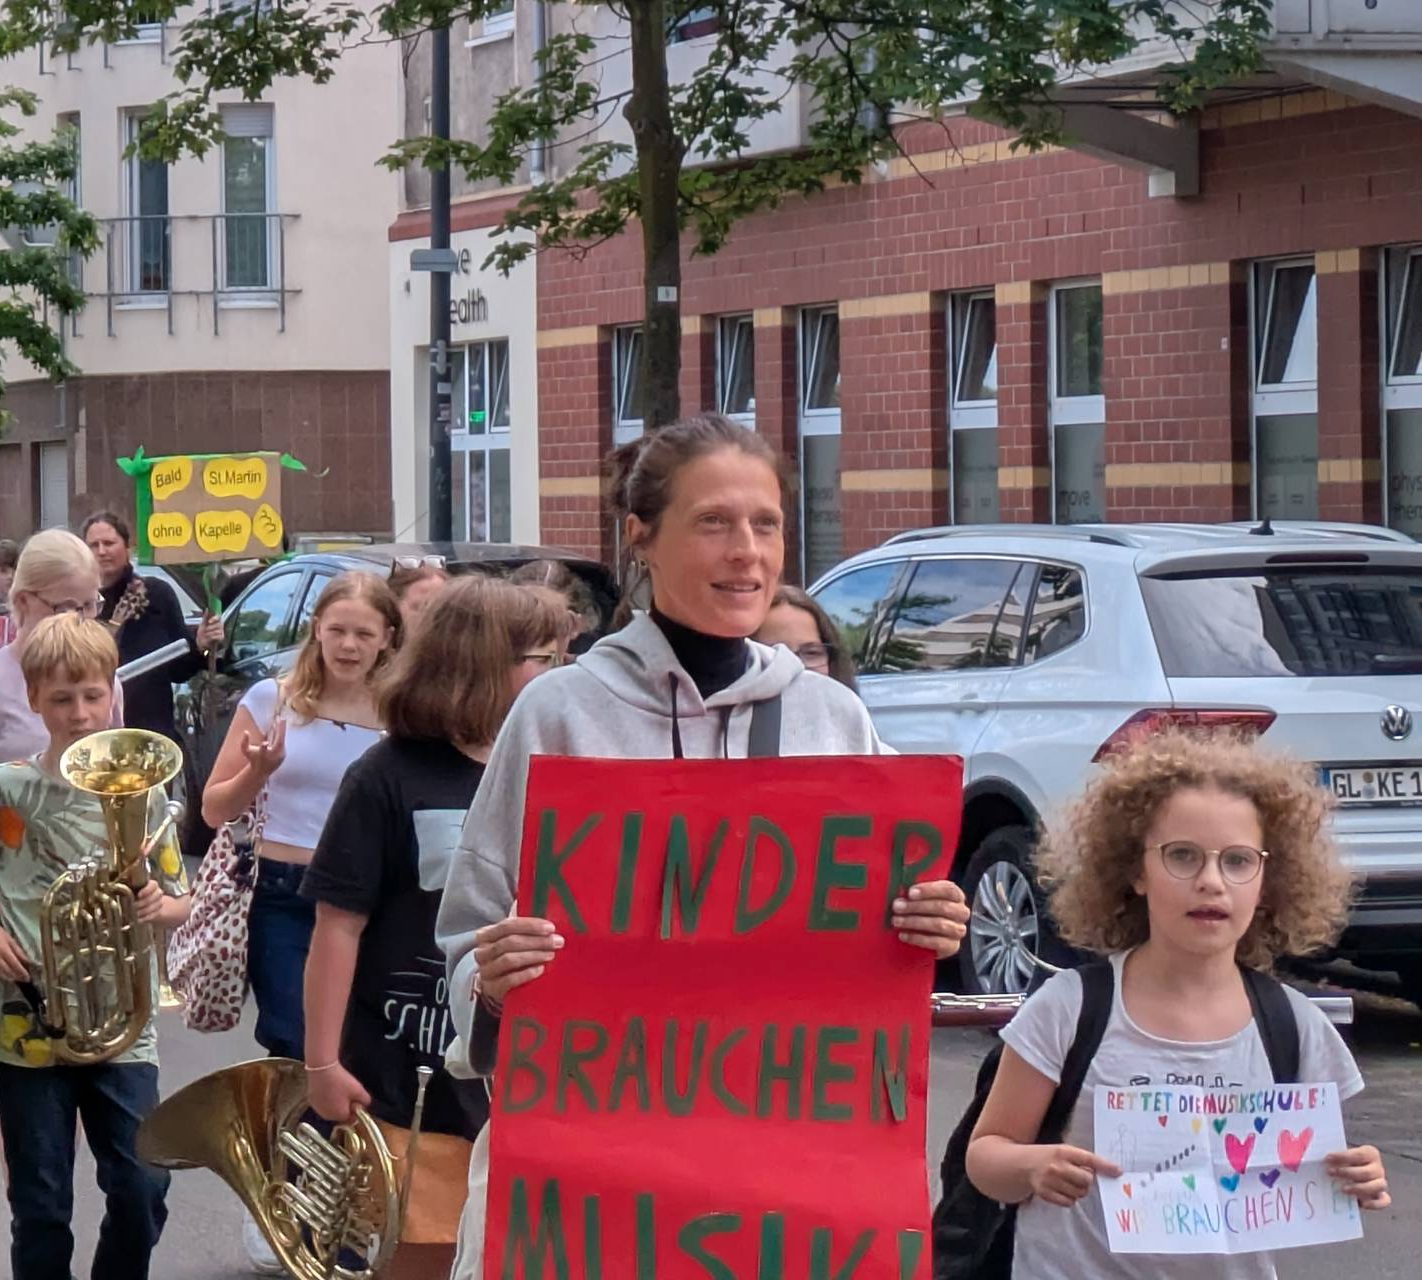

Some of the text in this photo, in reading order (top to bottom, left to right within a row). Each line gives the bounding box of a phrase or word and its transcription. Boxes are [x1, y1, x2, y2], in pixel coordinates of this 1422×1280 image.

[450, 287, 488, 324] ealth
[155, 467, 182, 488] Bald
[153, 524, 183, 538] ohne
[199, 521, 242, 539] Kapelle
[1333, 773, 1362, 798] GL
[1377, 771, 1407, 797] KE
[501, 1016, 911, 1124] BRAUCHEN
[1107, 1091, 1173, 1113] RETTET
[1162, 1186, 1294, 1235] BRAUCHEN
